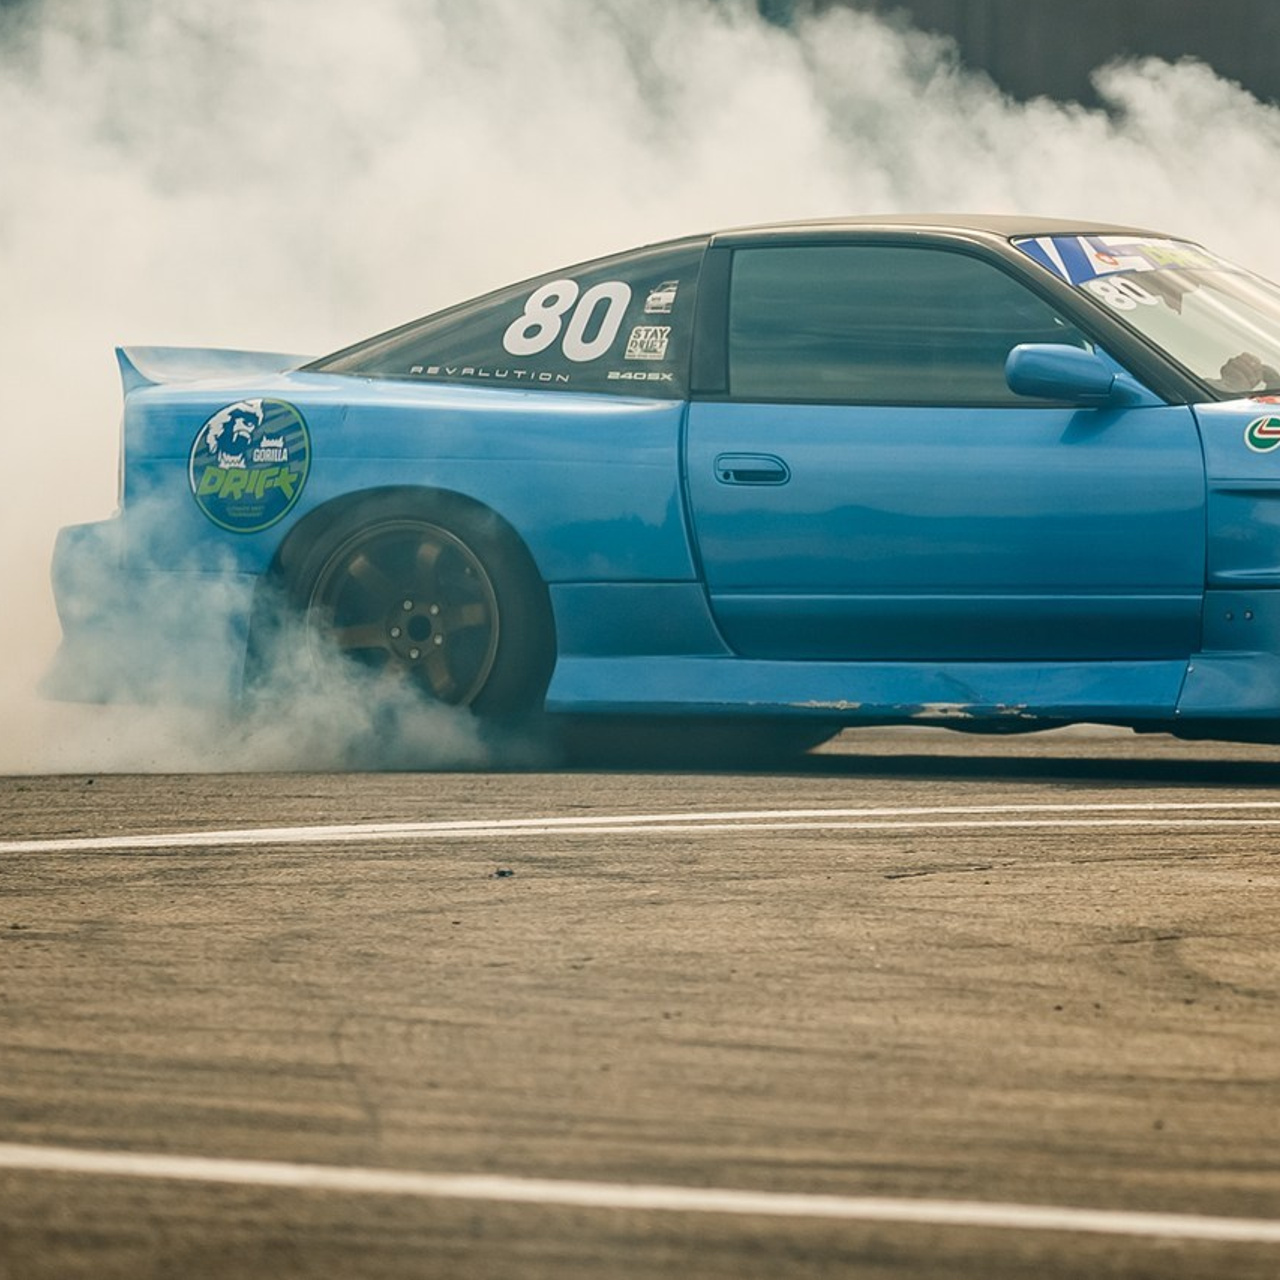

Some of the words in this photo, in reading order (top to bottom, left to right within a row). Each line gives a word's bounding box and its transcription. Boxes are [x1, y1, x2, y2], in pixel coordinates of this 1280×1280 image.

[1088, 276, 1159, 311] 80
[502, 279, 632, 362] 80
[633, 328, 668, 340] STAY
[629, 340, 666, 350] DRIFT
[410, 366, 570, 382] REVALUTION
[607, 371, 674, 381] 240SX
[253, 448, 288, 463] GORILLA
[197, 465, 298, 501] DRIFT
